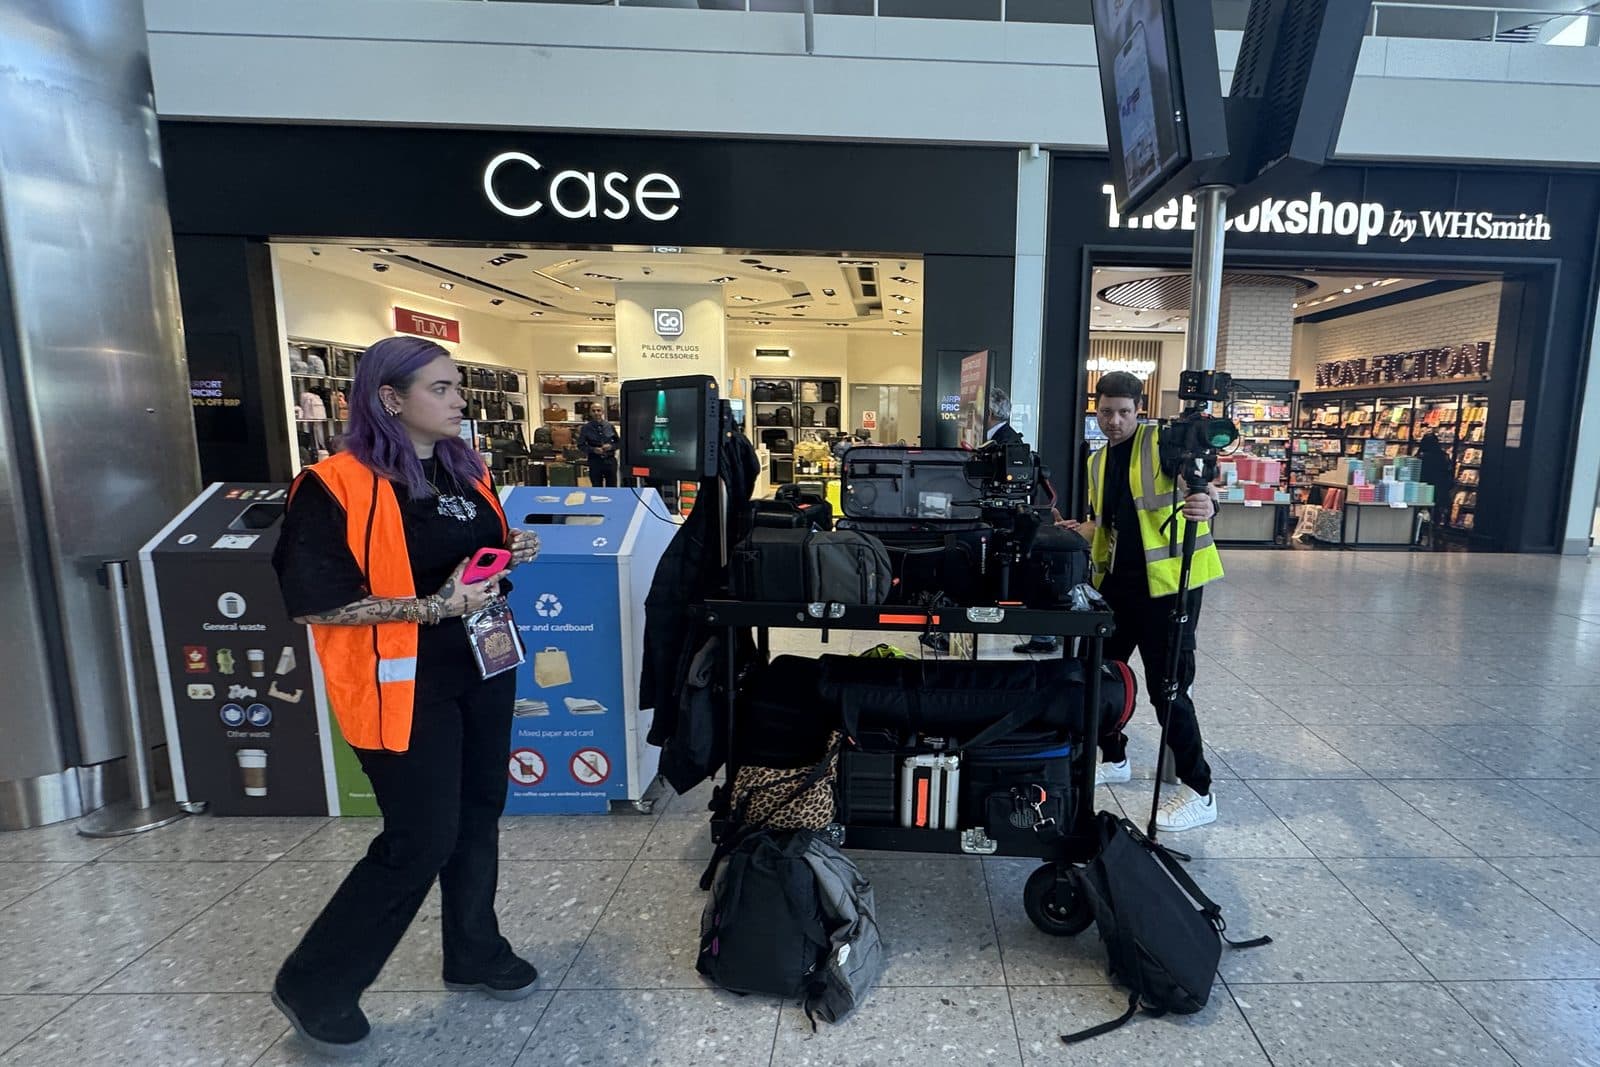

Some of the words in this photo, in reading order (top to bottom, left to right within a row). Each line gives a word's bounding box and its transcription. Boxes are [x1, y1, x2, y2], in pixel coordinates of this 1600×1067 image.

[484, 152, 681, 221] Case
[1389, 210, 1417, 242] by
[1420, 210, 1551, 240] WHSmith
[658, 312, 679, 327] Go
[412, 315, 448, 337] TUMI
[650, 352, 700, 360] ACCESSORIES
[1315, 342, 1490, 389] NON-FICTION
[203, 623, 238, 631] General
[532, 624, 549, 632] and
[550, 624, 594, 632] cardboard
[226, 730, 247, 738] Other
[518, 729, 541, 737] Mixed
[542, 730, 561, 739] paper
[563, 729, 577, 737] and
[578, 729, 594, 737] card
